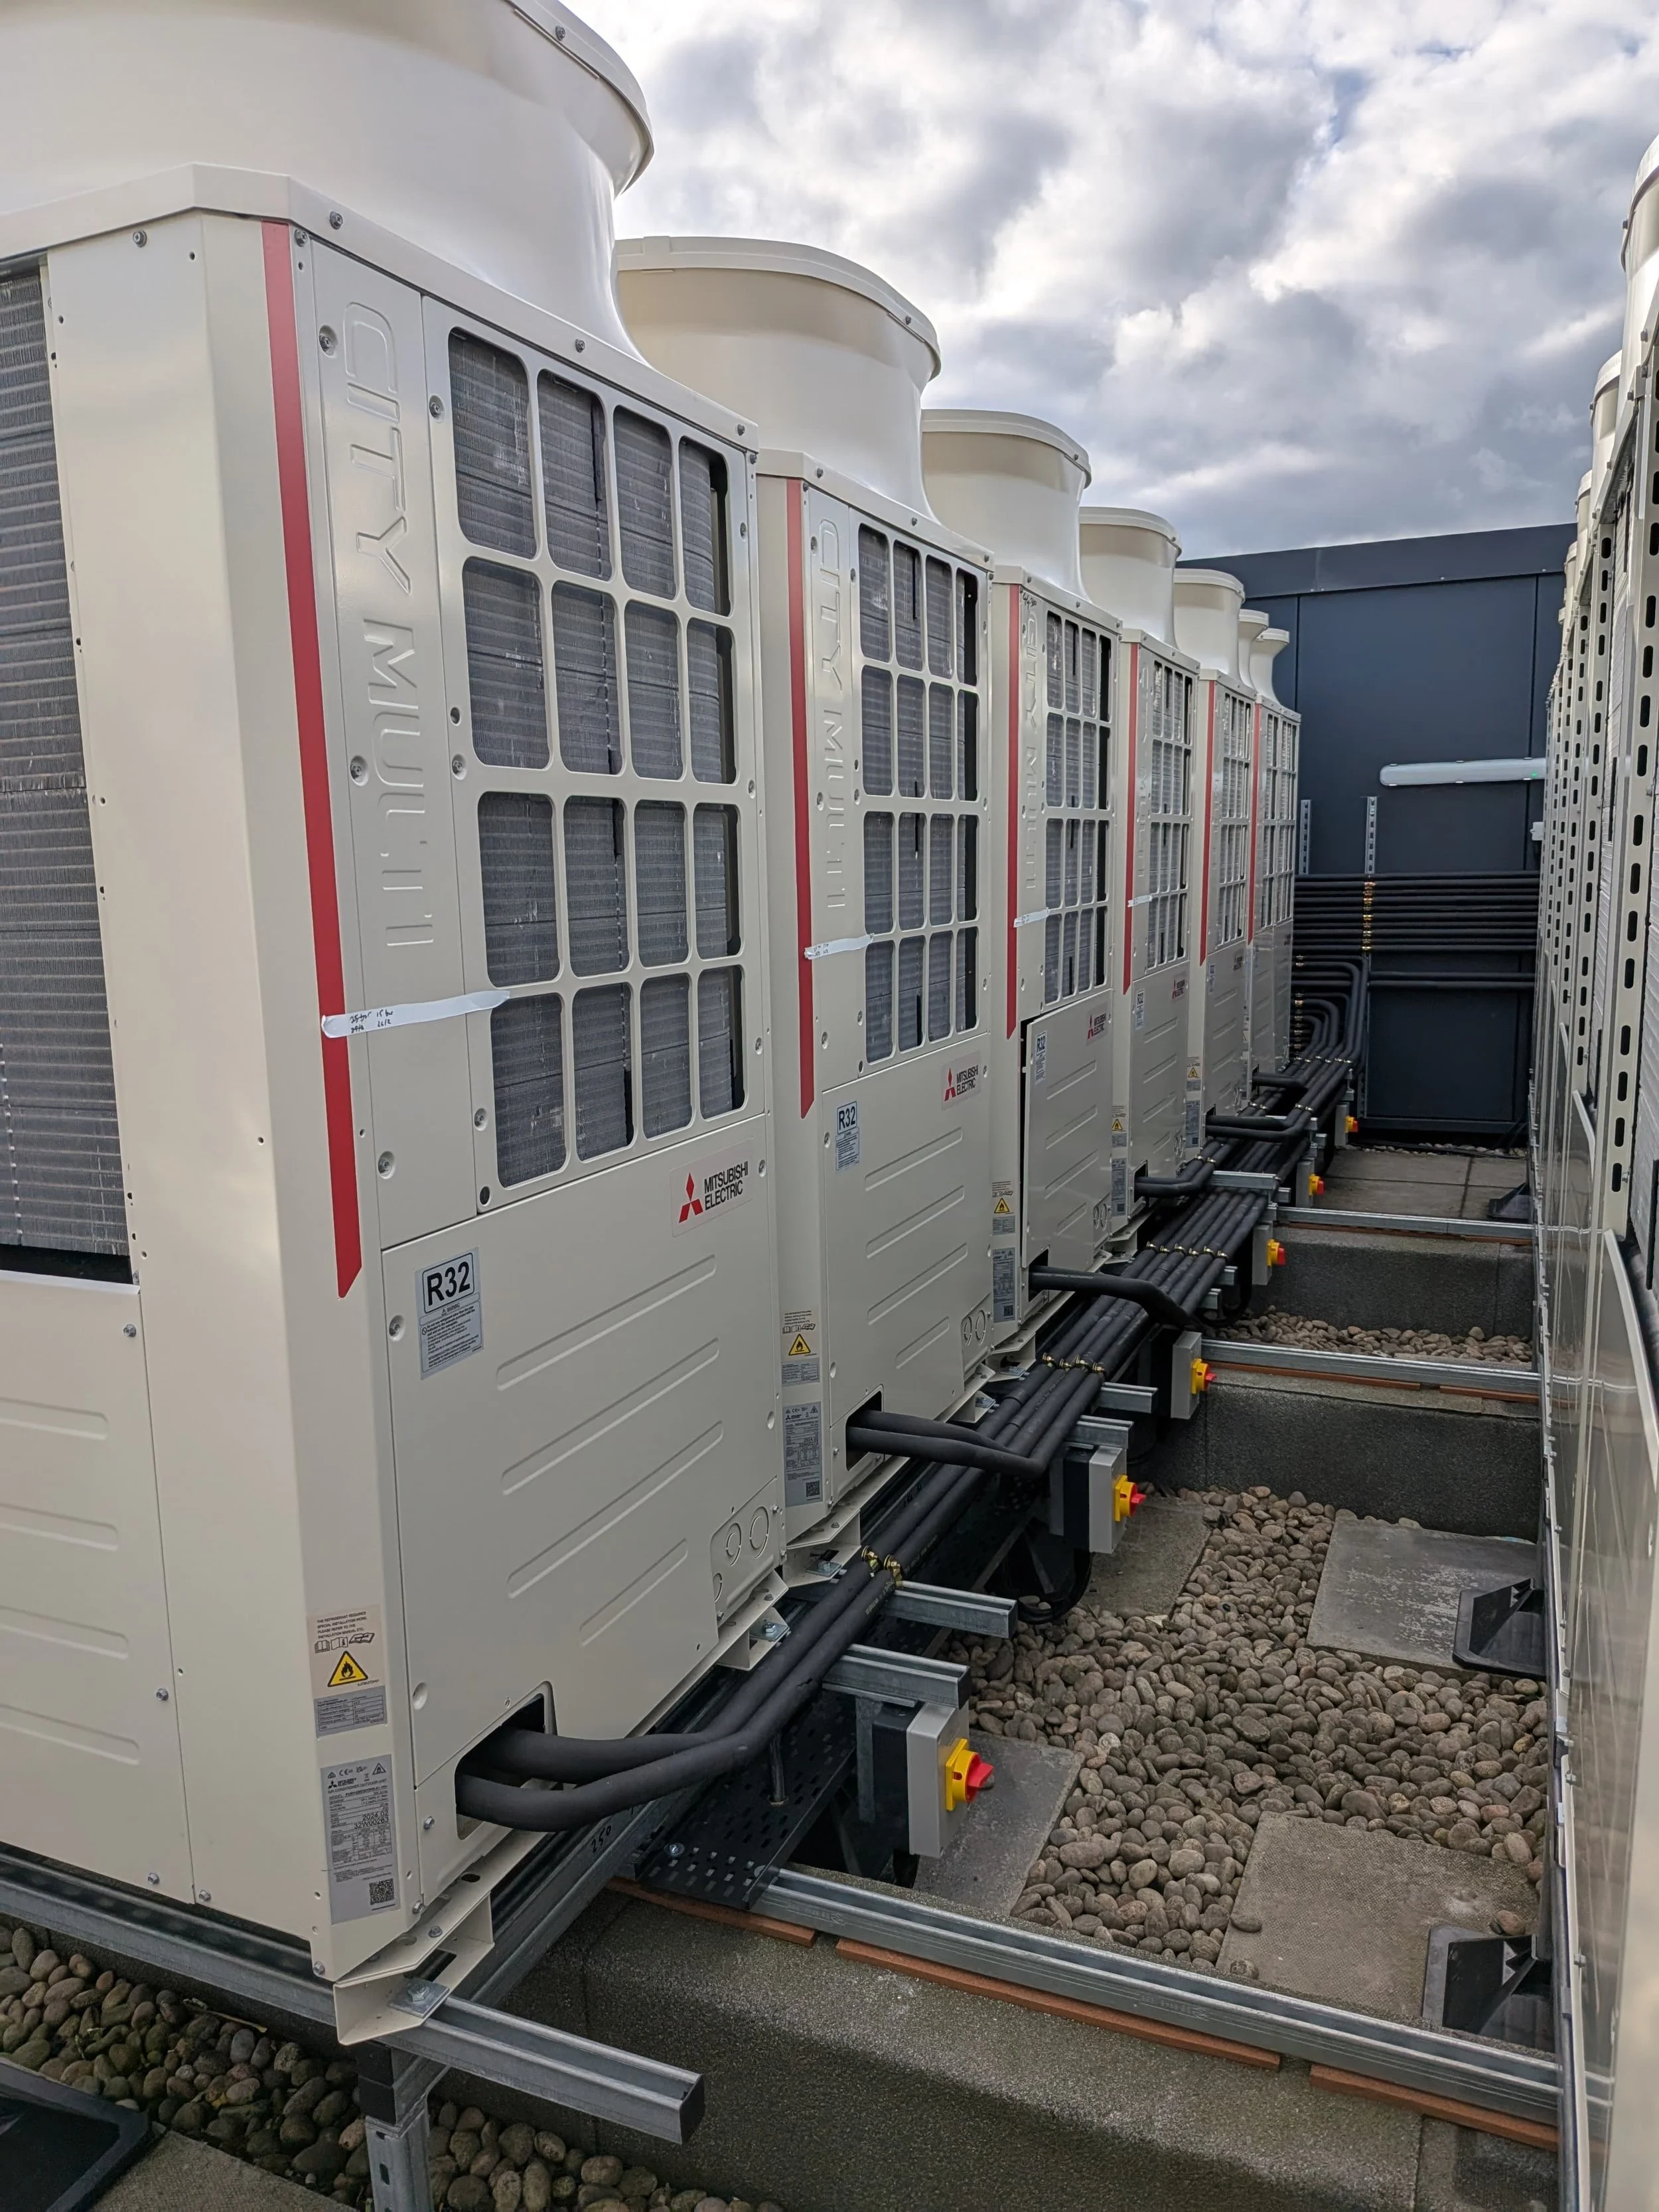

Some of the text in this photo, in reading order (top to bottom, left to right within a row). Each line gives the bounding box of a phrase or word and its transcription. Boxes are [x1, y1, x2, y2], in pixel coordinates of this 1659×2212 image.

[819, 518, 842, 693] CITY
[343, 301, 435, 946] CITY MULTI
[1037, 1035, 1046, 1053] R32
[956, 1065, 979, 1084] MITSUBISHI
[957, 1078, 975, 1096] ELECTRIC
[838, 1106, 855, 1131] R32
[704, 1161, 749, 1193] MITSUBISHI
[705, 1179, 743, 1211] ELECTRIC
[427, 1261, 470, 1306] R32
[591, 1825, 612, 1853] 250
